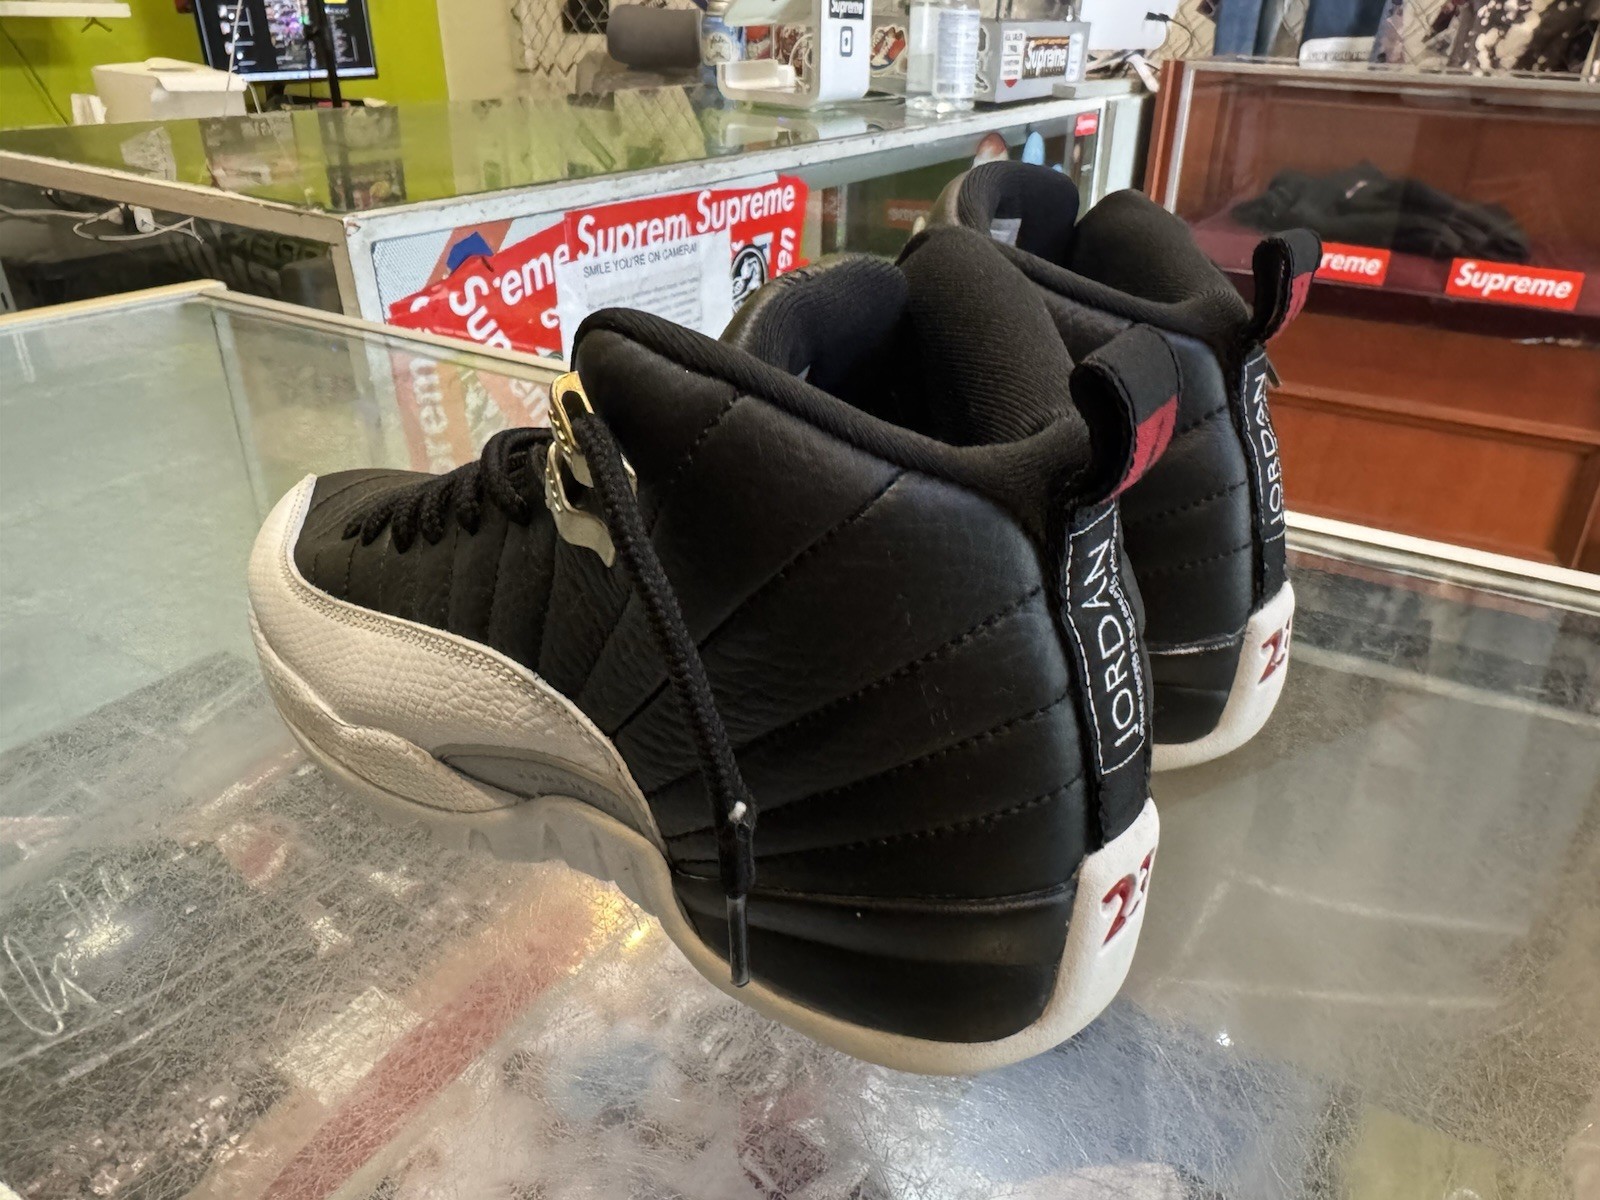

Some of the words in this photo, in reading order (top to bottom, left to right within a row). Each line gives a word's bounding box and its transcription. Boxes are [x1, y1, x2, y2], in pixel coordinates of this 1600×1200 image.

[1025, 40, 1067, 76] Supreme
[695, 184, 797, 235] Supreme
[576, 213, 692, 261] Suprem
[583, 261, 612, 278] SMILE
[612, 254, 646, 272] YOU'RE
[647, 251, 661, 264] ON
[1319, 252, 1383, 275] reme
[1454, 262, 1573, 299] Supreme
[1253, 373, 1284, 525] JORDAN
[1082, 538, 1139, 749] JORDAN
